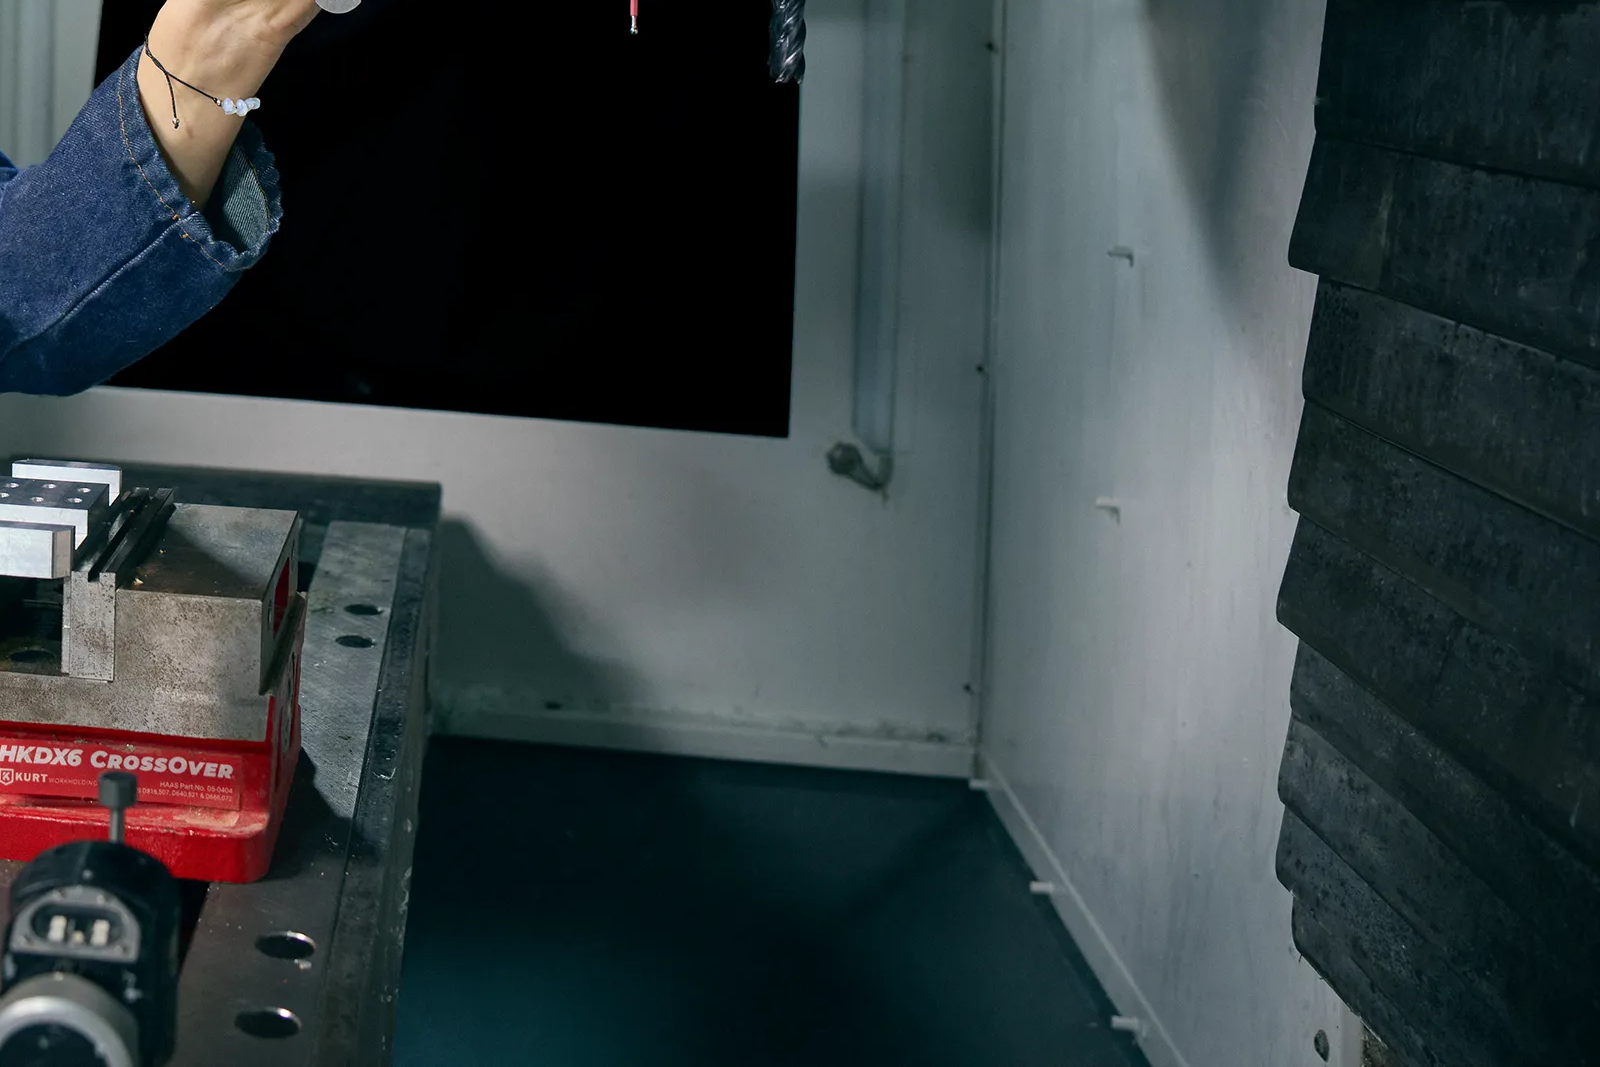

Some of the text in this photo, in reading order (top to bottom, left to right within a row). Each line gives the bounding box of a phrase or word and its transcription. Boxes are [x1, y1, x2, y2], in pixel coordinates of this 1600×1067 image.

[15, 771, 48, 783] KURT
[48, 778, 98, 787] WORKHOLDING
[159, 781, 179, 789] HAAS
[180, 782, 194, 790] Part
